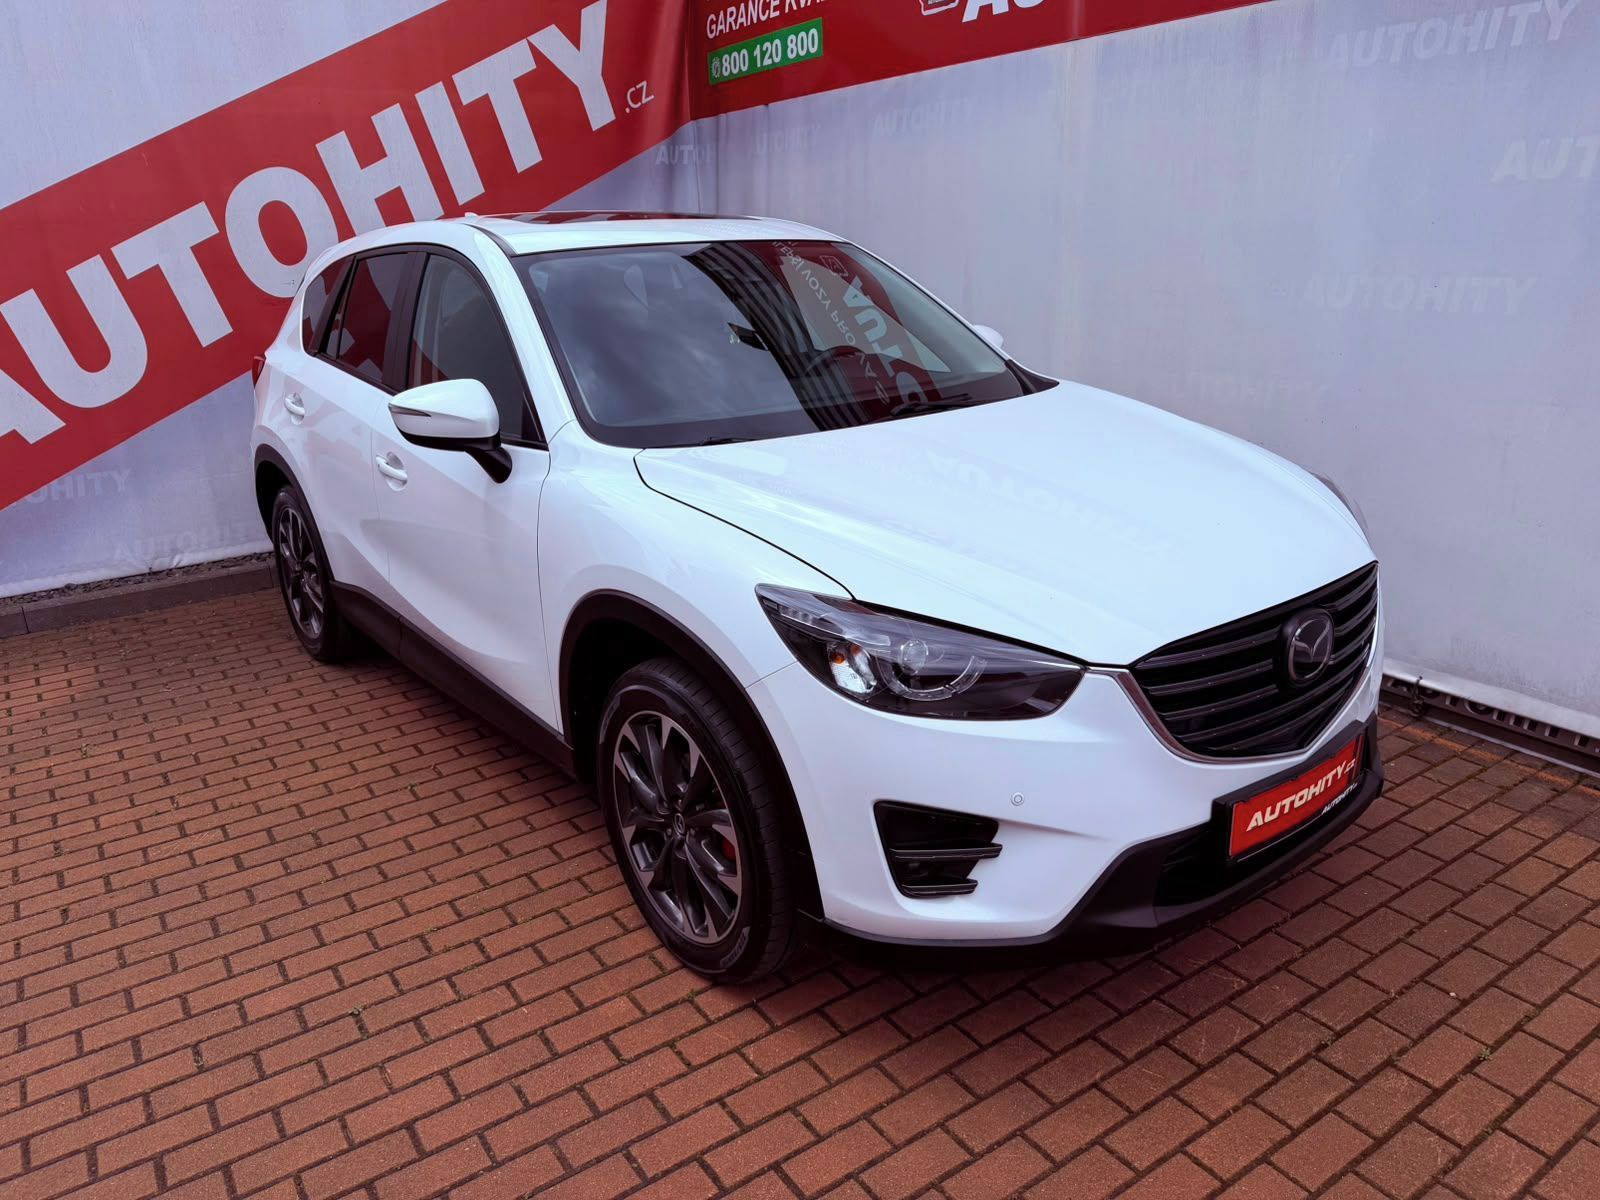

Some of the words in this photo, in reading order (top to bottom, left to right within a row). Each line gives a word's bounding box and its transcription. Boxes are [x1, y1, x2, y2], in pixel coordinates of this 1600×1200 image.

[706, 0, 781, 39] GARANCE
[721, 48, 749, 77] 800
[754, 38, 782, 68] 120
[787, 28, 819, 60] 800
